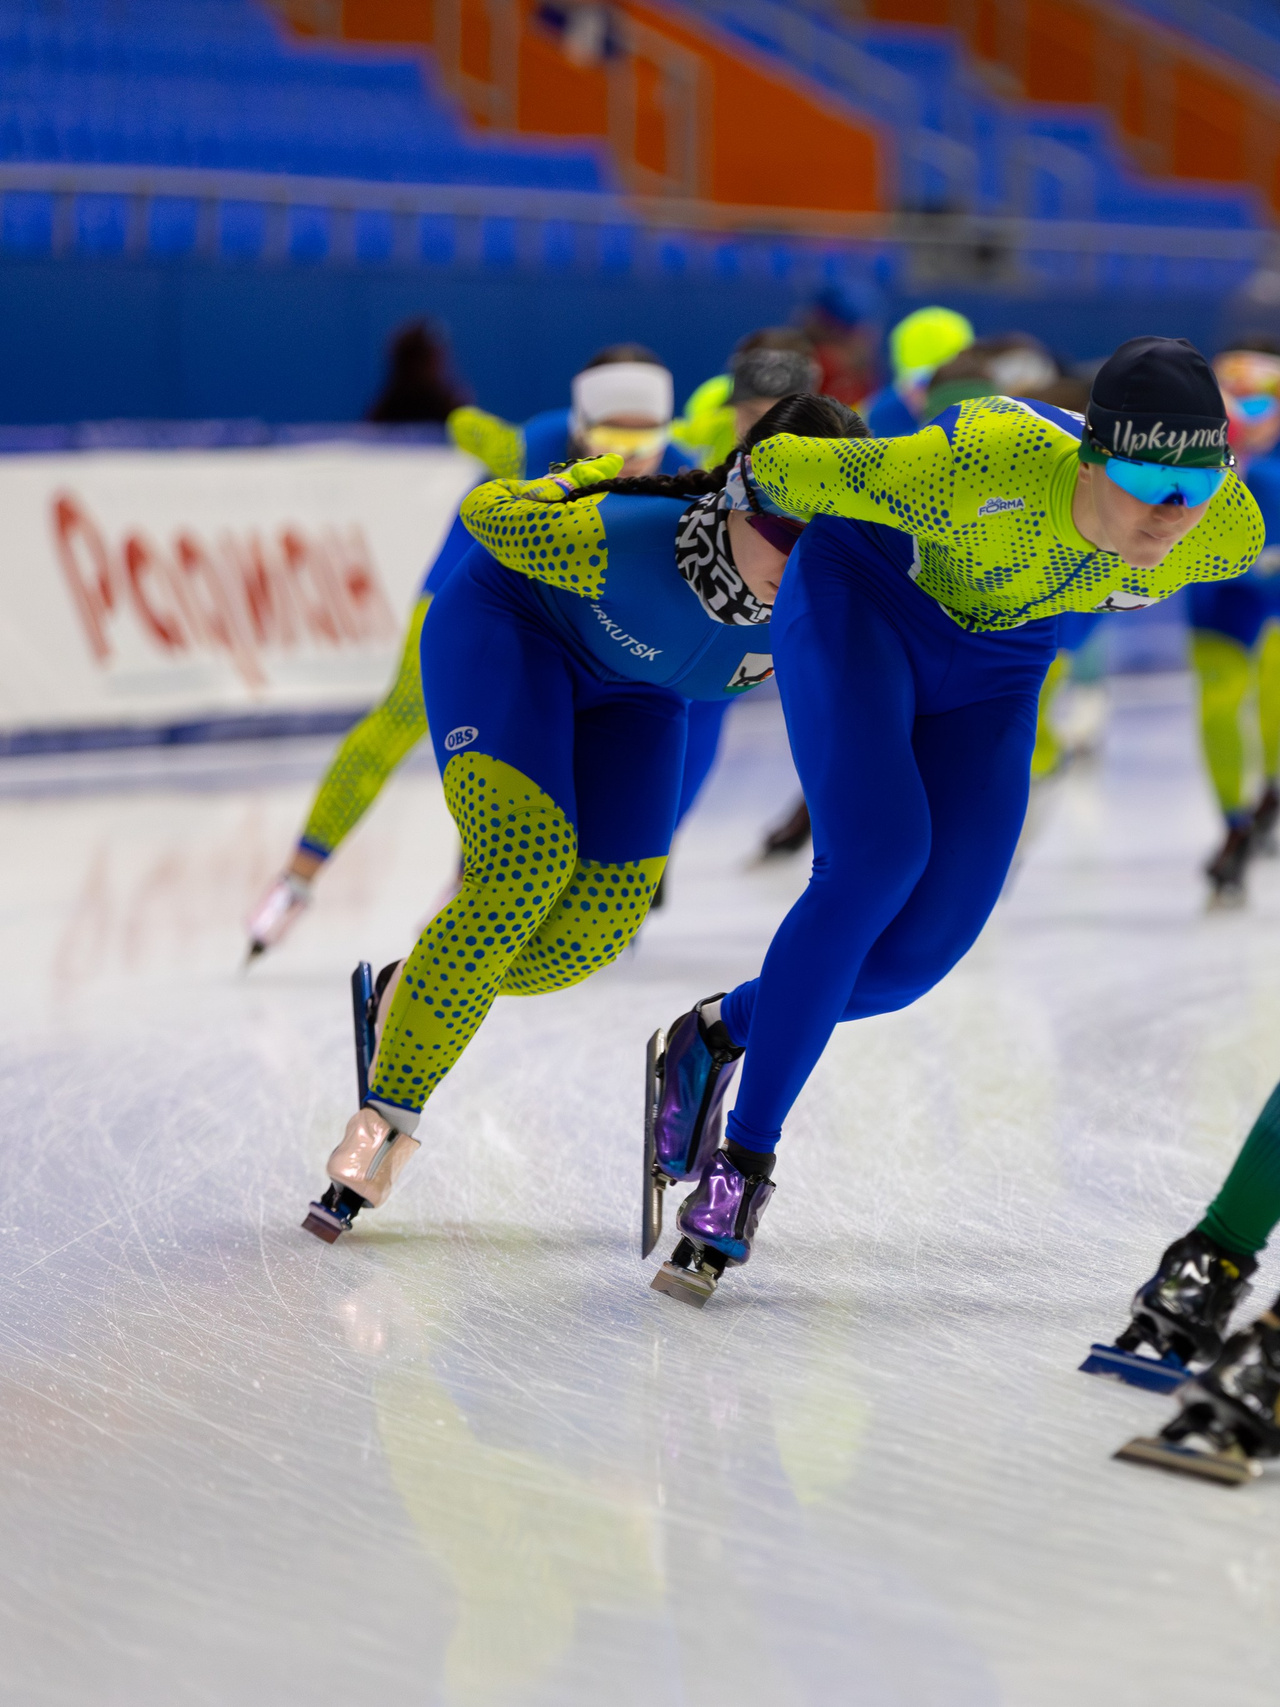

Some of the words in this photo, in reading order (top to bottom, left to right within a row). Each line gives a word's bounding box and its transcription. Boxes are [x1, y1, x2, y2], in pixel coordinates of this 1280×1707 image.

[978, 498, 1024, 516] FORMA
[590, 603, 664, 661] IRKUTSK
[448, 728, 473, 748] OBS
